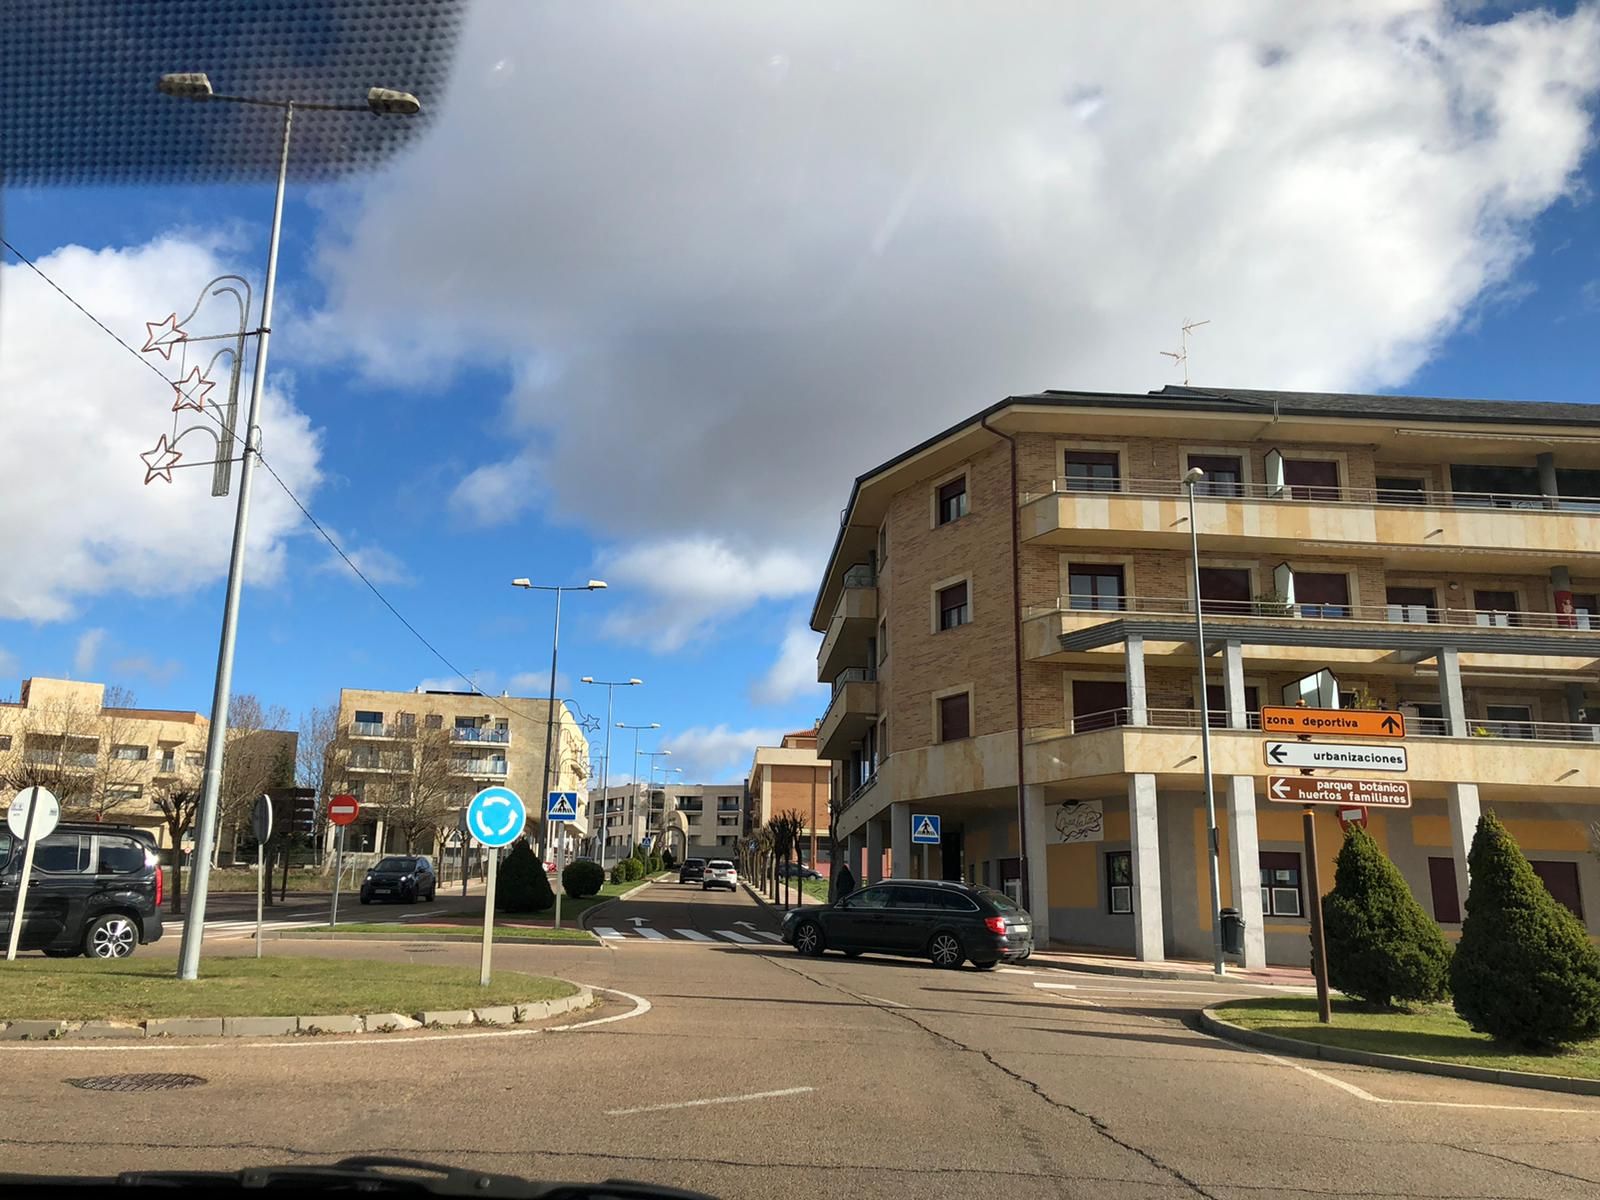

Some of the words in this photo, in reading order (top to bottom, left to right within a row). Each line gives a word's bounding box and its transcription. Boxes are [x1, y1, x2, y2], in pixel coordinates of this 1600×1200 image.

[1266, 716, 1295, 725] zona
[1302, 717, 1359, 728] deportiva
[1313, 752, 1403, 764] urbanizaciones
[1317, 781, 1353, 791] parque
[1359, 781, 1405, 793] botánico
[1298, 789, 1342, 800] huertos
[1348, 791, 1406, 804] familiares
